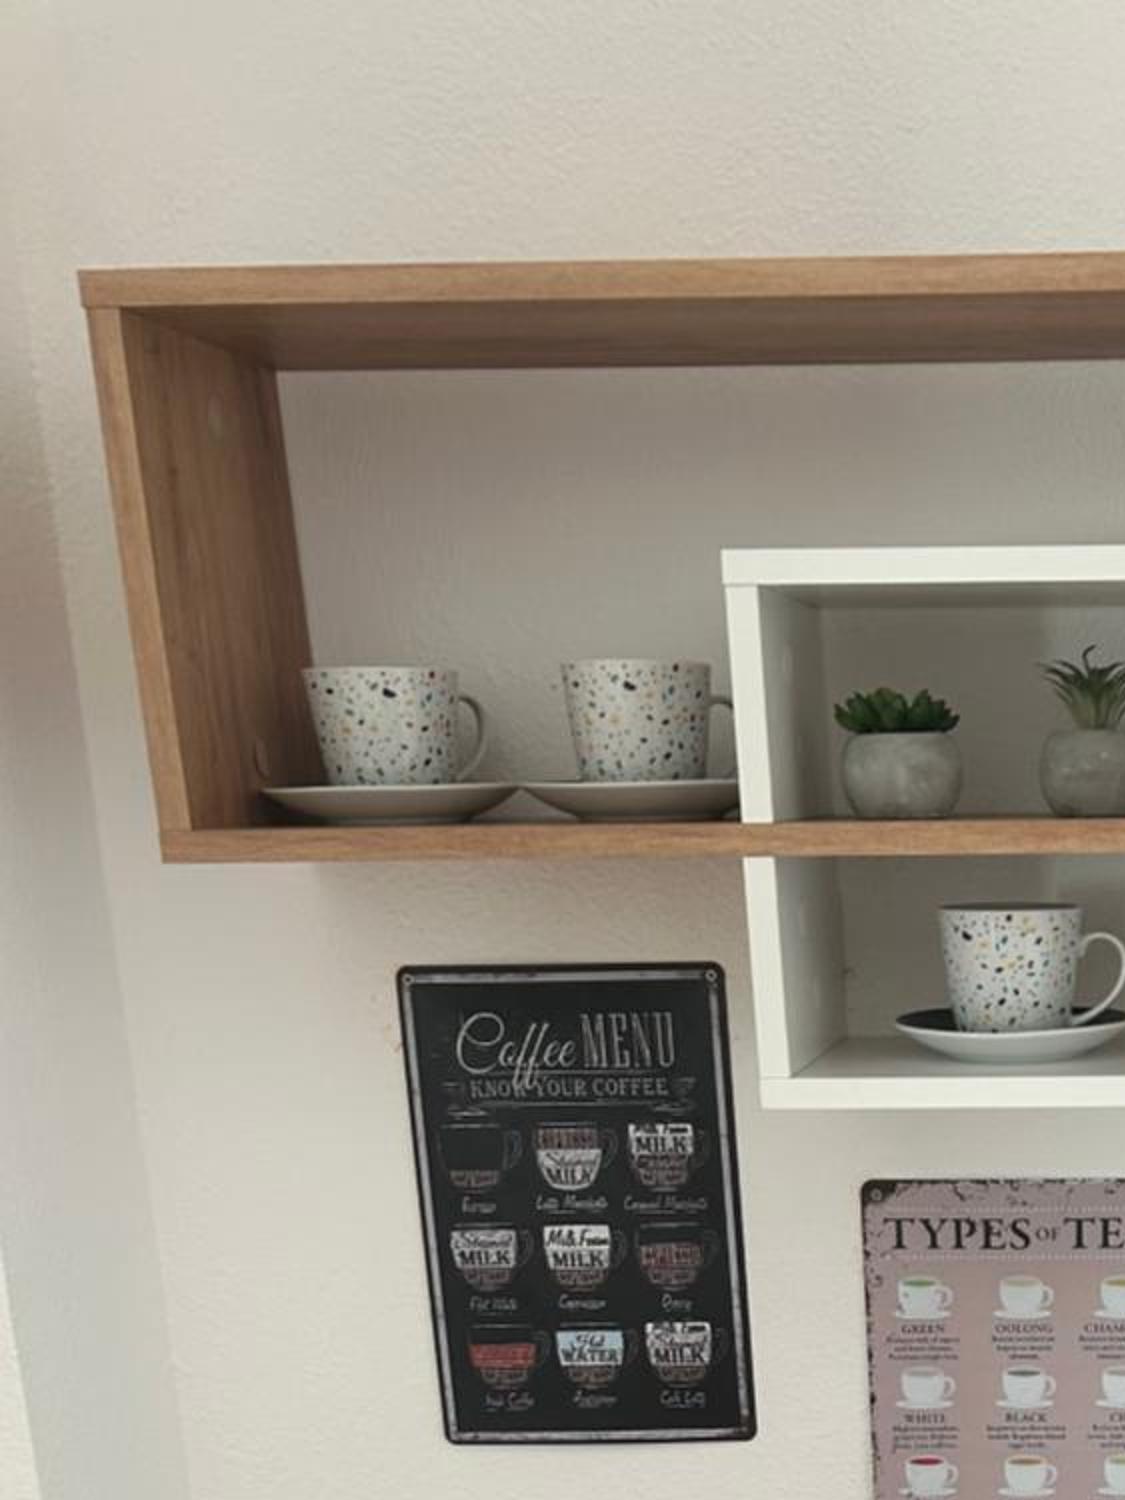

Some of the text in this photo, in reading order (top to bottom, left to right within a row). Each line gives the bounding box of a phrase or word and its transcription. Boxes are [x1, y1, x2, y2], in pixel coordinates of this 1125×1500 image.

[456, 1011, 675, 1090] Coffee MENU
[470, 1076, 670, 1099] KNOW YOUR COFFEE
[634, 1134, 689, 1153] MILK
[883, 1216, 1031, 1250] TYPES
[457, 1249, 512, 1266] MILK
[552, 1250, 606, 1267] MILK
[654, 1346, 709, 1367] MILK
[1005, 1412, 1048, 1423] BLACK
